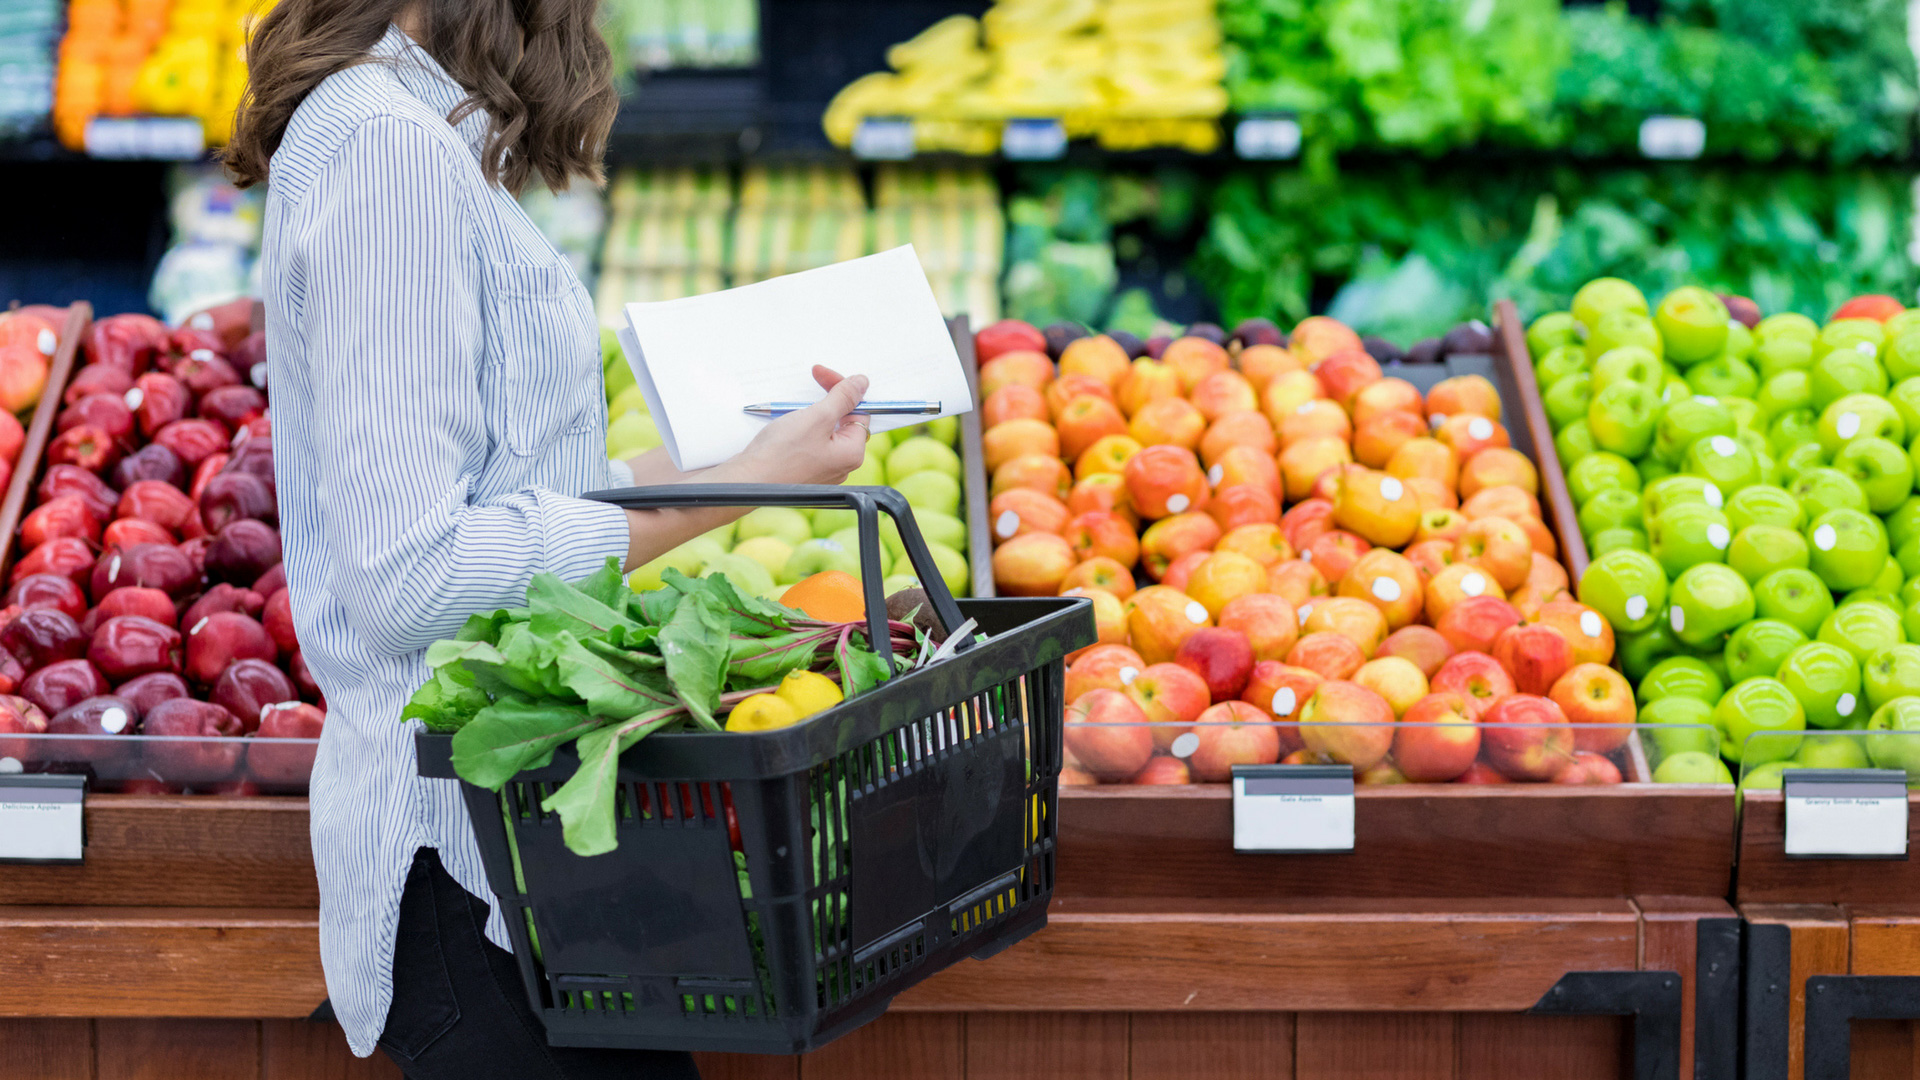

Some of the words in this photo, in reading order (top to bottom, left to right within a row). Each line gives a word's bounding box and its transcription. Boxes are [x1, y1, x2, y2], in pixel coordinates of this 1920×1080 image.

[1299, 795, 1322, 803] Apples
[1805, 798, 1830, 806] Granny
[1856, 798, 1880, 806] Apples
[37, 803, 61, 811] Apples
